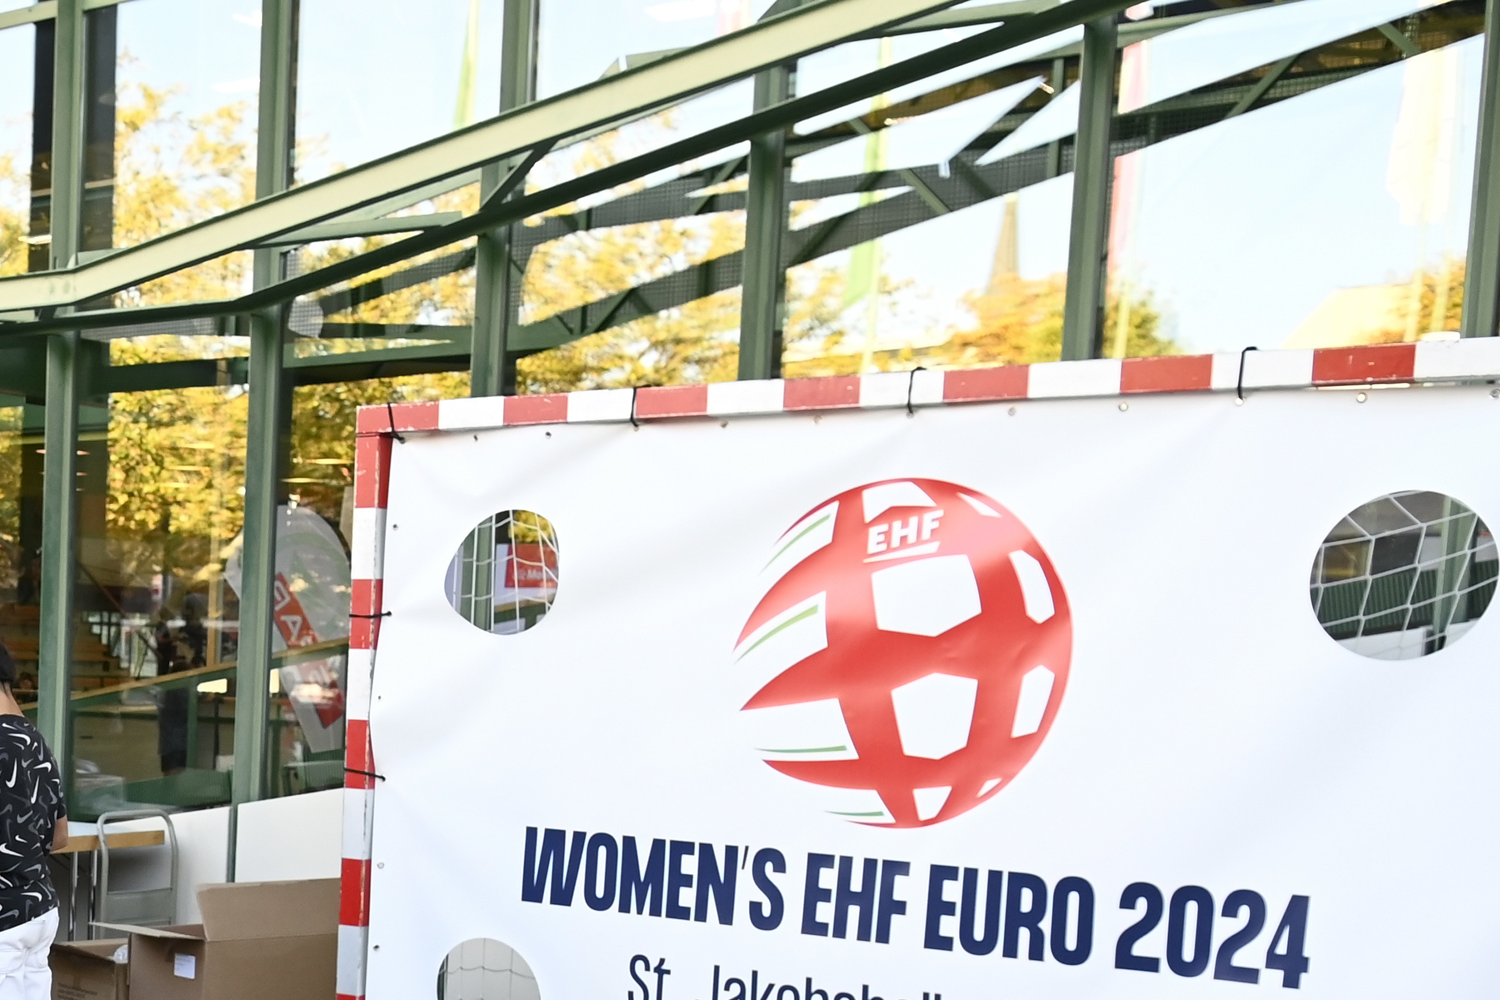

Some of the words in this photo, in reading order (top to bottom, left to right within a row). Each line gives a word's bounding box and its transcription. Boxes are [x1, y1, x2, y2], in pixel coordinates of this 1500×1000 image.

[867, 509, 944, 554] EHF
[521, 826, 787, 931] WOMEN'S
[801, 852, 911, 944] EHF
[923, 864, 1095, 966] EURO
[1114, 881, 1311, 989] 2024
